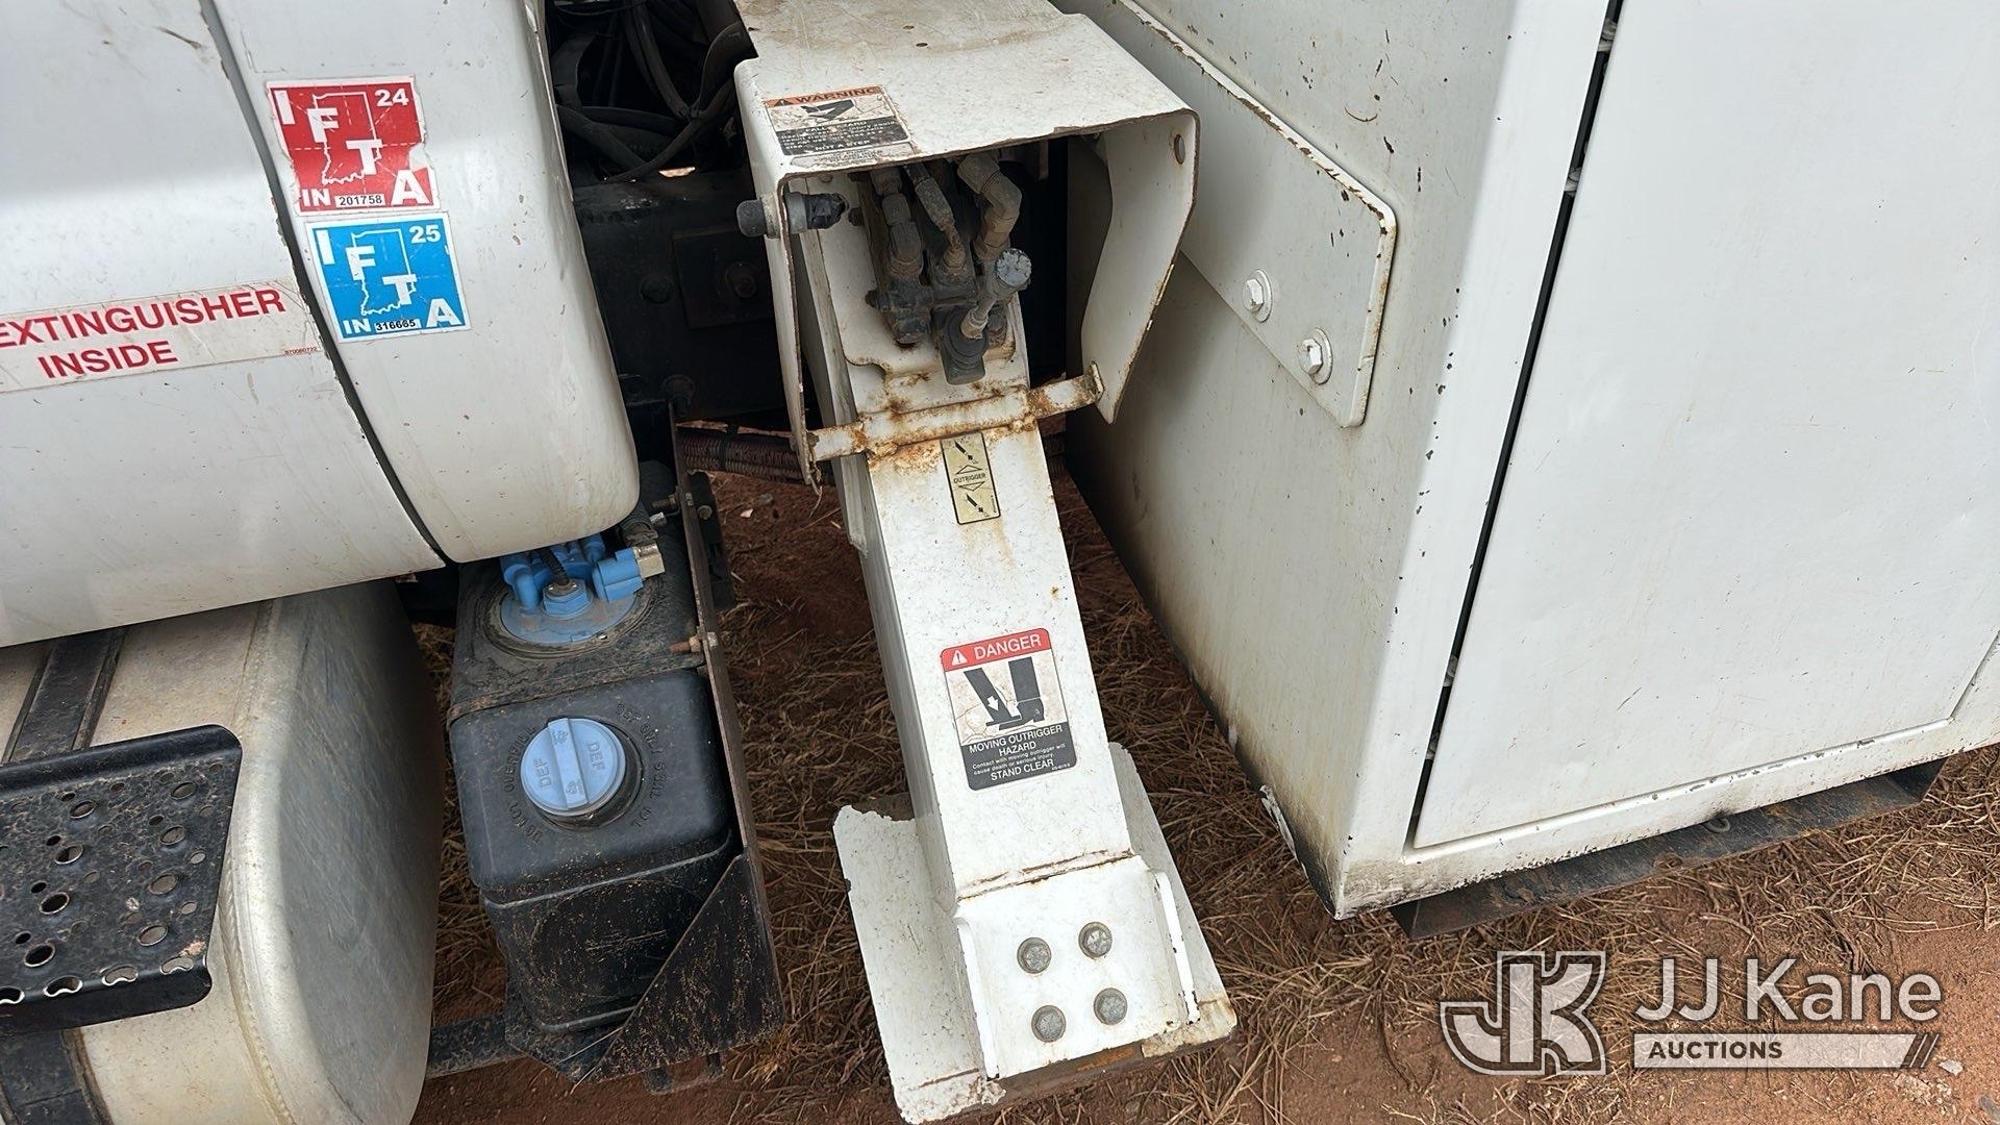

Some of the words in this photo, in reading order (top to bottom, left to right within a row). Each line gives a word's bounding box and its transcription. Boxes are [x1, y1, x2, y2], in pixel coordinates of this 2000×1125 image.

[374, 88, 409, 107] 24
[795, 86, 878, 104] WARNING
[302, 188, 332, 207] IN
[338, 195, 383, 206] 201758
[409, 224, 441, 244] 25
[0, 289, 286, 349] EXTINGUISHER
[343, 319, 371, 335] IN
[376, 319, 416, 332] 316665
[38, 340, 178, 379] INSIDE
[953, 473, 986, 483] OUTRIGGER
[974, 633, 1043, 660] DANGER
[969, 737, 1006, 754] MOVING
[1008, 724, 1063, 744] OUTRIGGER
[998, 740, 1036, 757] HAZARD
[587, 742, 606, 770] DEF
[990, 766, 1022, 781] STAND
[1023, 758, 1054, 773] CLEAR
